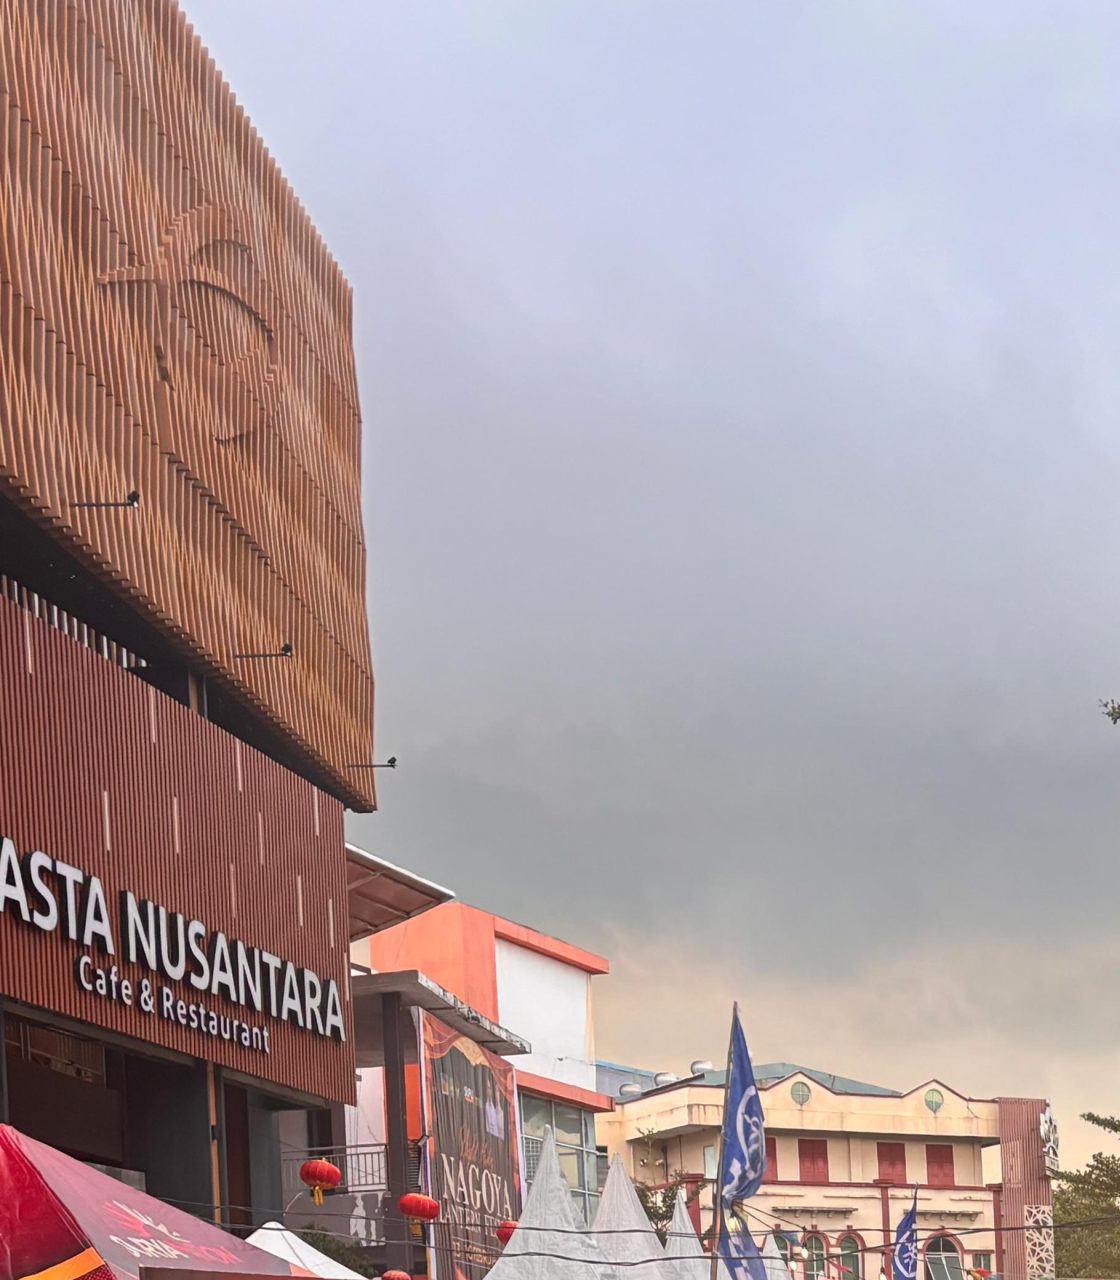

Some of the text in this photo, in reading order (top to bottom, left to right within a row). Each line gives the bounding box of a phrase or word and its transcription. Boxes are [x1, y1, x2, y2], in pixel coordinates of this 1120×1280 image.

[0, 836, 346, 1042] ASTA NUSANTARA
[79, 955, 270, 1054] Cafe & Restaurant
[441, 1153, 513, 1221] NAGOYA
